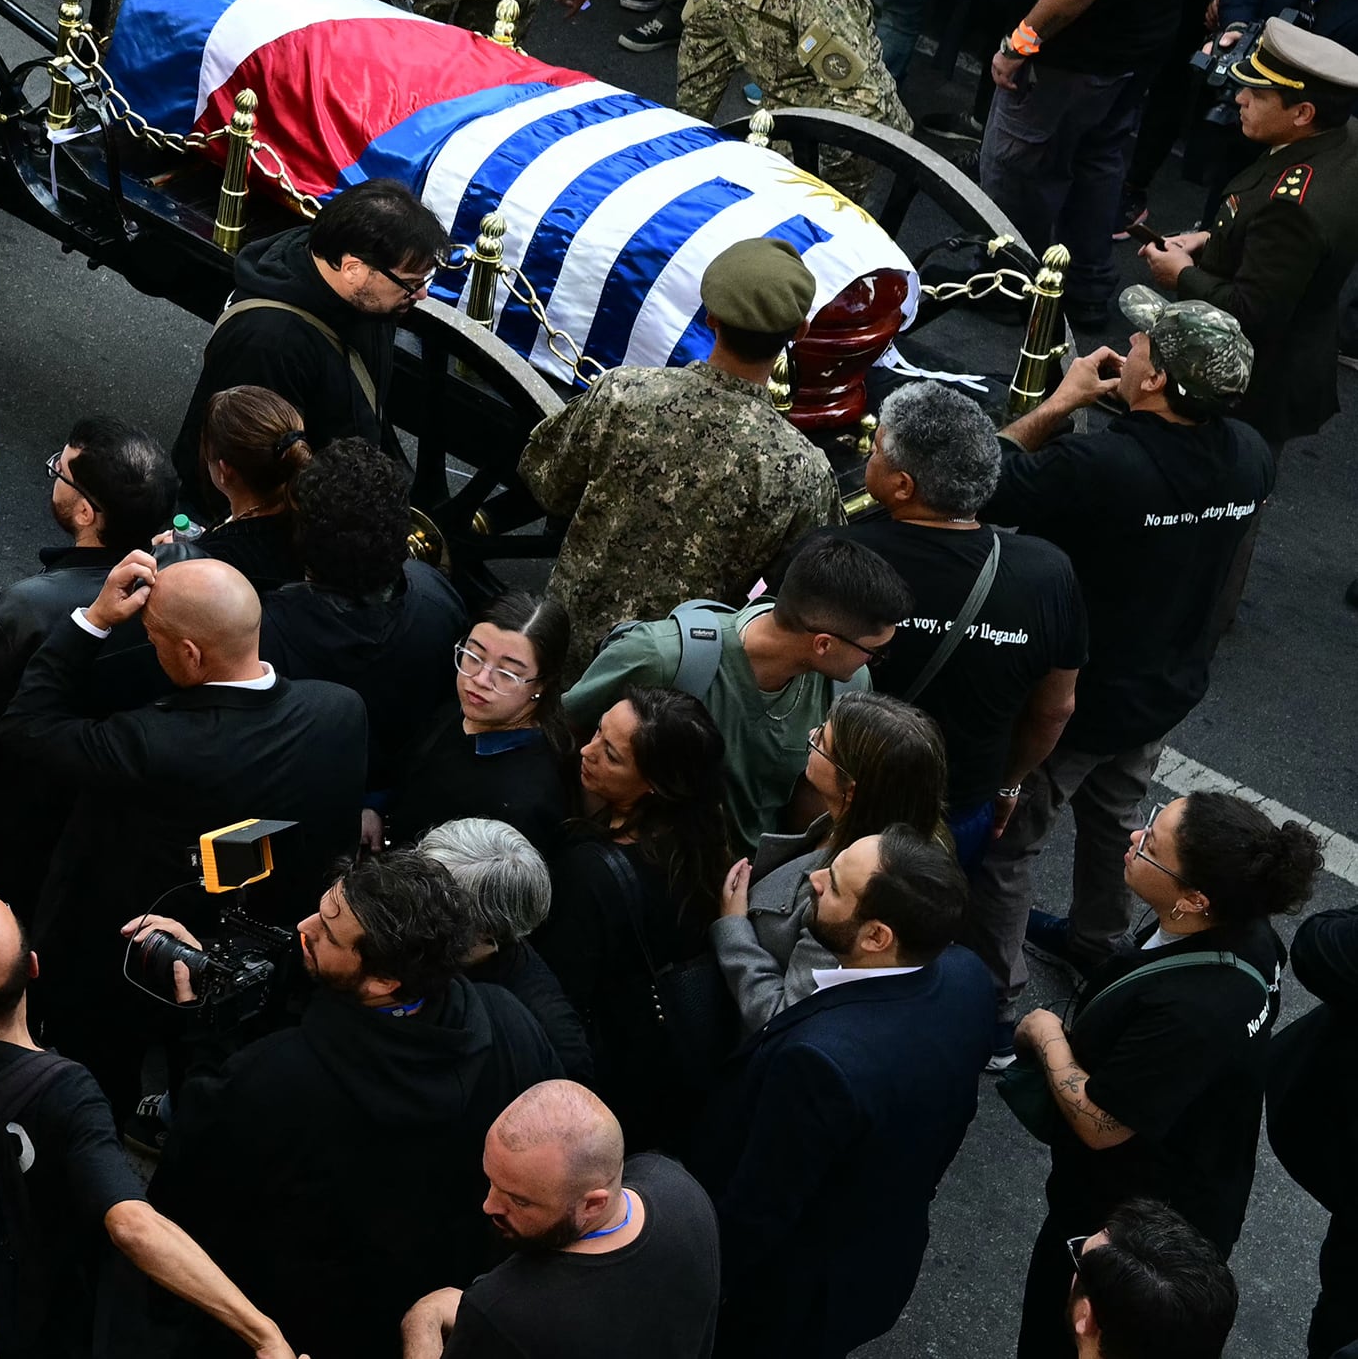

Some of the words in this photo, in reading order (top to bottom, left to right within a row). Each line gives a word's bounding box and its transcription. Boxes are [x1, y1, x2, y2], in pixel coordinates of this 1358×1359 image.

[1144, 513, 1161, 527] No
[1162, 513, 1179, 526] me
[913, 617, 941, 634] voy,
[980, 623, 1029, 646] llegando
[1246, 1019, 1260, 1038] No
